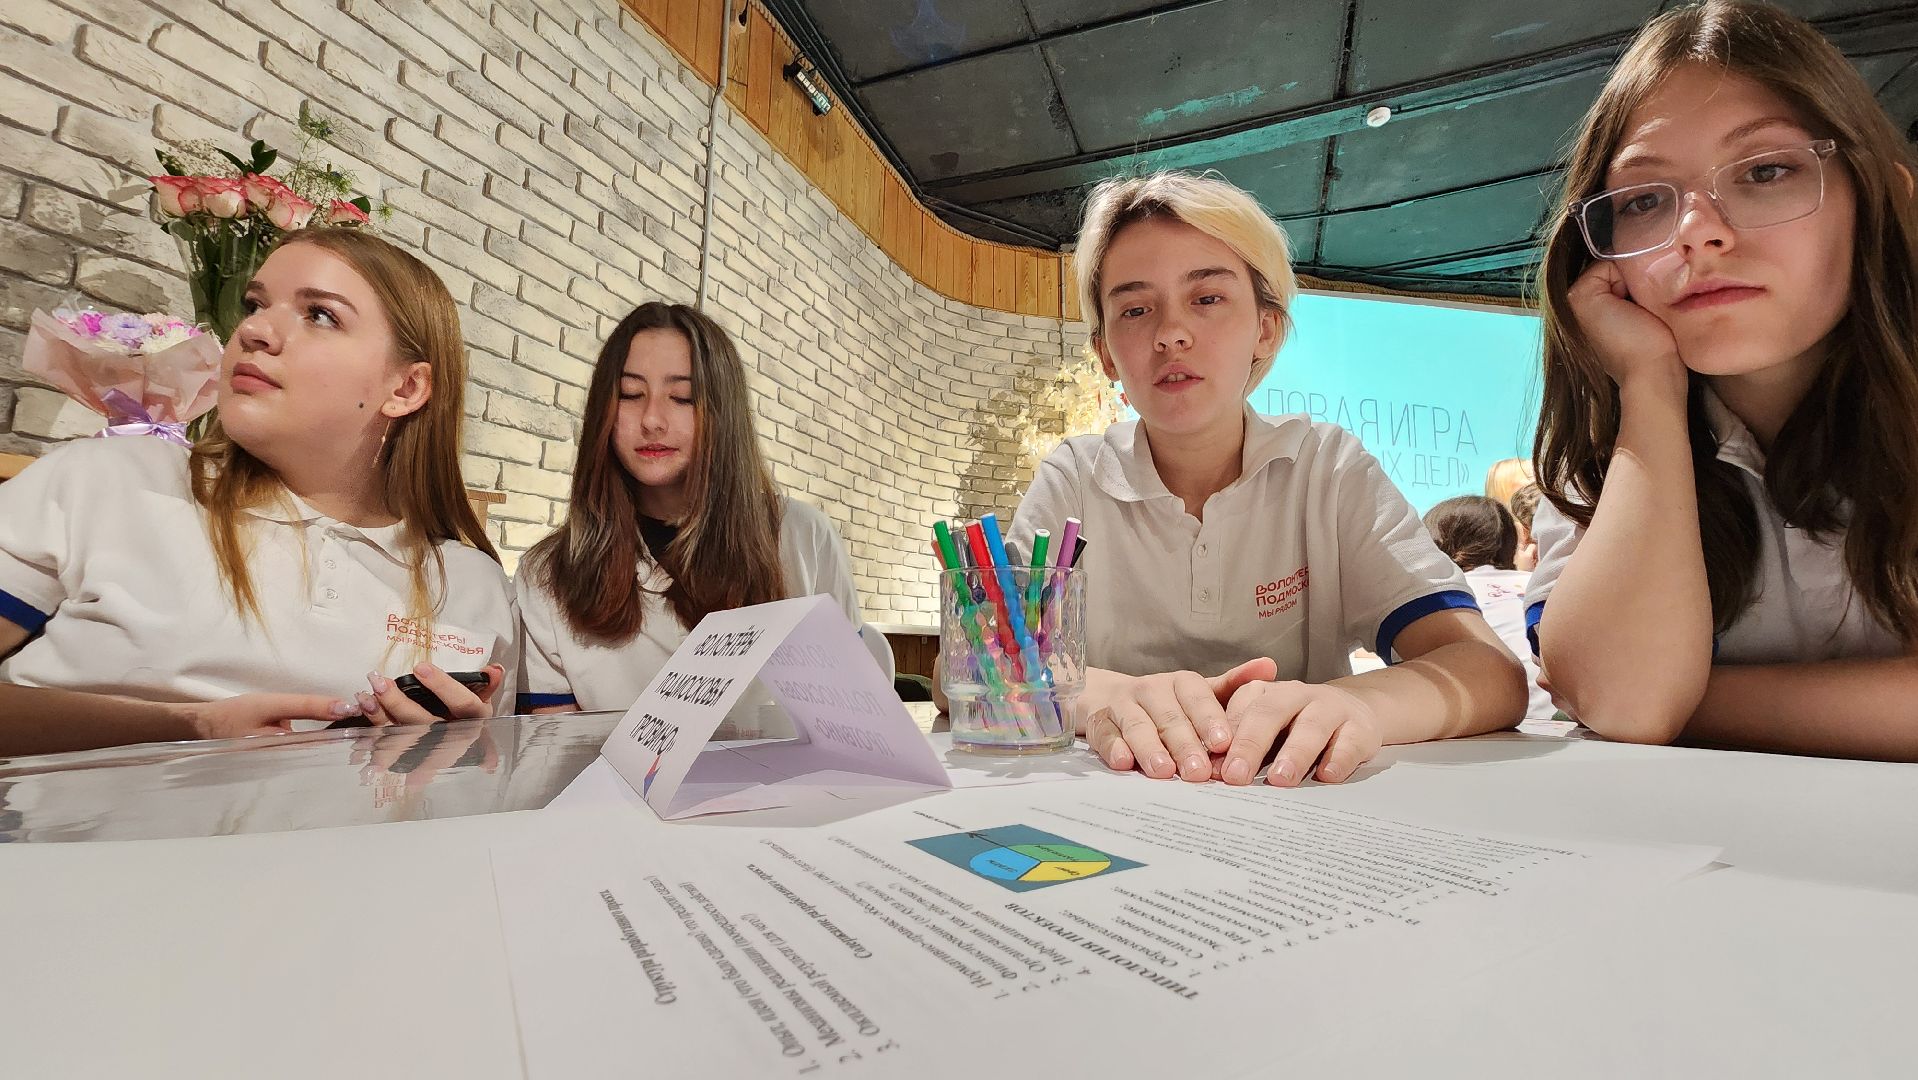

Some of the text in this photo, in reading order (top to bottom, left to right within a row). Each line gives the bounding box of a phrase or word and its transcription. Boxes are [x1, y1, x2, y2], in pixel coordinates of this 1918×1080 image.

[1390, 401, 1478, 455] ИГРА
[1411, 453, 1470, 489] ДЕЛ»
[1255, 580, 1309, 607] ПОДМОСК
[655, 671, 735, 708] ПОДМОСКОВЬЯ
[629, 713, 679, 756] ПРОТВИНО»
[816, 917, 872, 959] Содержание
[969, 928, 1046, 973] Организация
[1004, 902, 1197, 999] ТИПОЛОГИЯ ПРОЕКТОВ
[640, 958, 677, 1005] Структура
[783, 988, 843, 1047] Механизмы
[810, 979, 879, 1036] Ожидаемый
